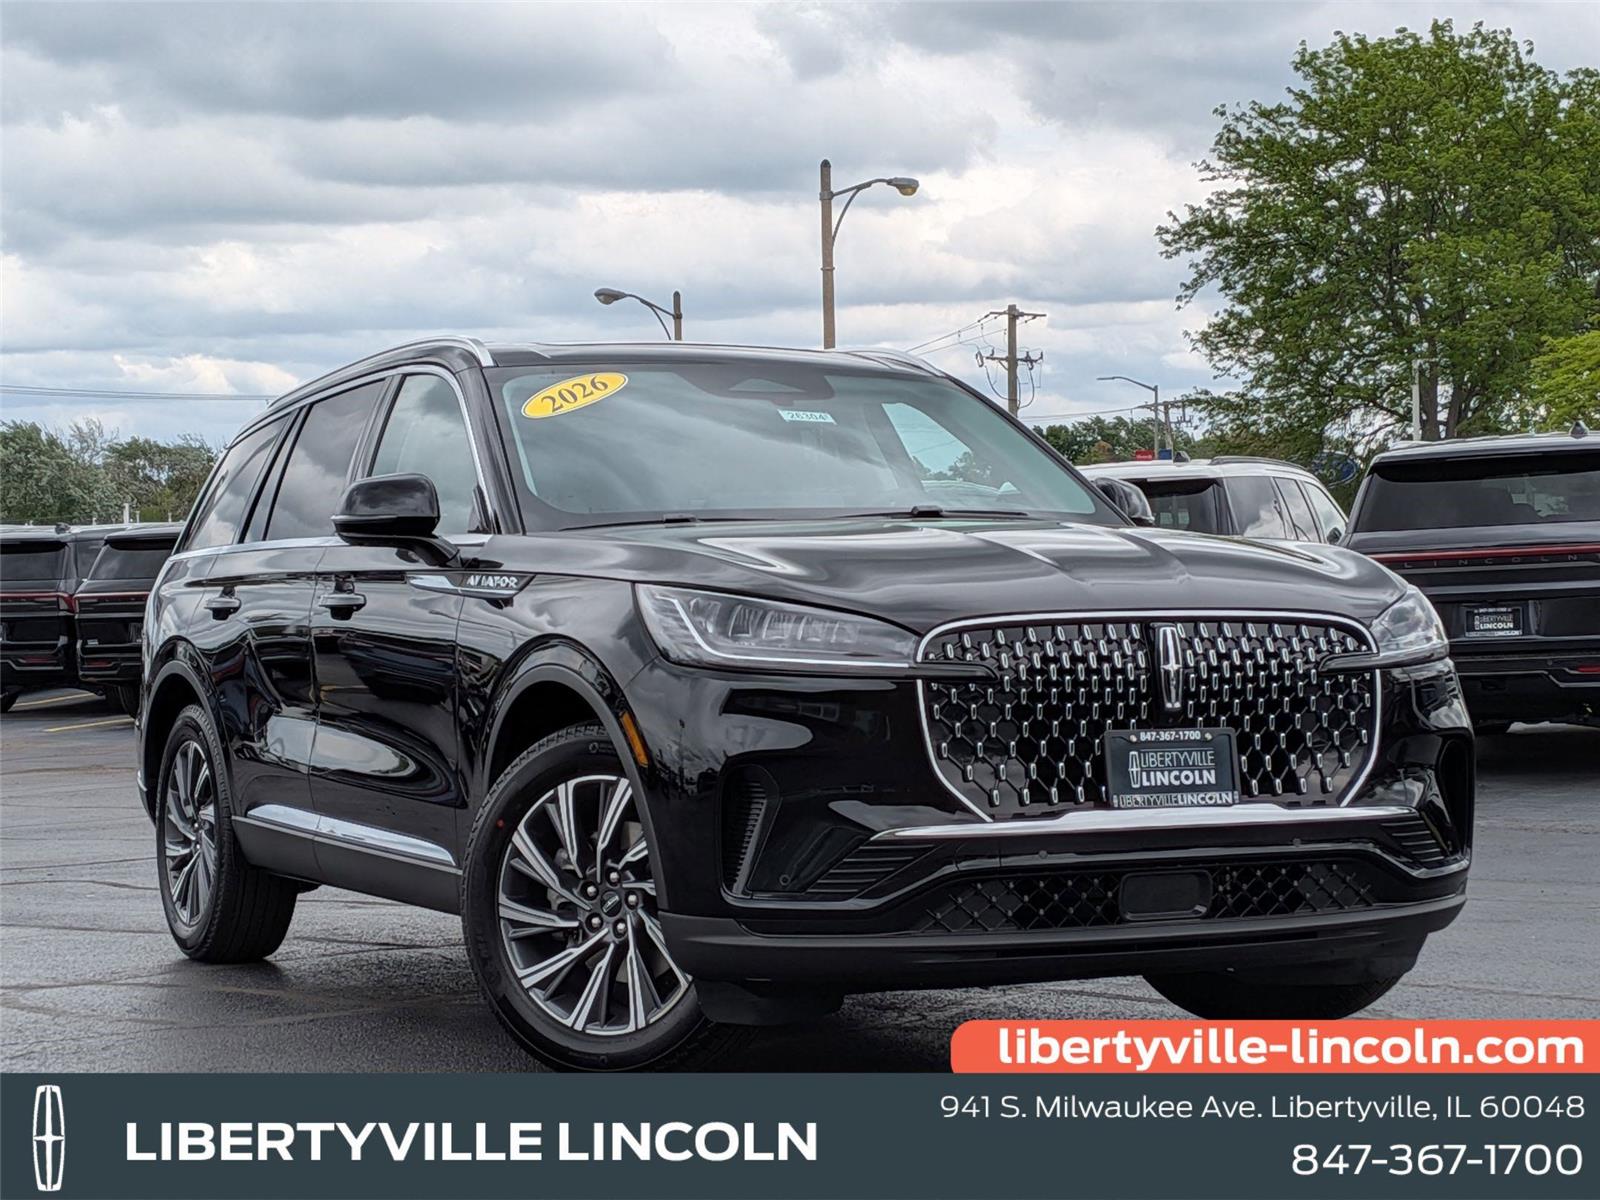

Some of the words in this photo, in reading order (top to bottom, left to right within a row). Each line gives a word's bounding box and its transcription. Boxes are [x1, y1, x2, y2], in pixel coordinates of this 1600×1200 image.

[541, 376, 608, 412] 2026
[1404, 554, 1577, 569] LINCOLN
[466, 574, 518, 589] AVIATOR
[1480, 622, 1513, 630] LINCOLN
[1139, 730, 1201, 742] 847-367-1700
[1140, 750, 1216, 768] LIBERTYVILLE
[1141, 769, 1217, 787] LINCOLN
